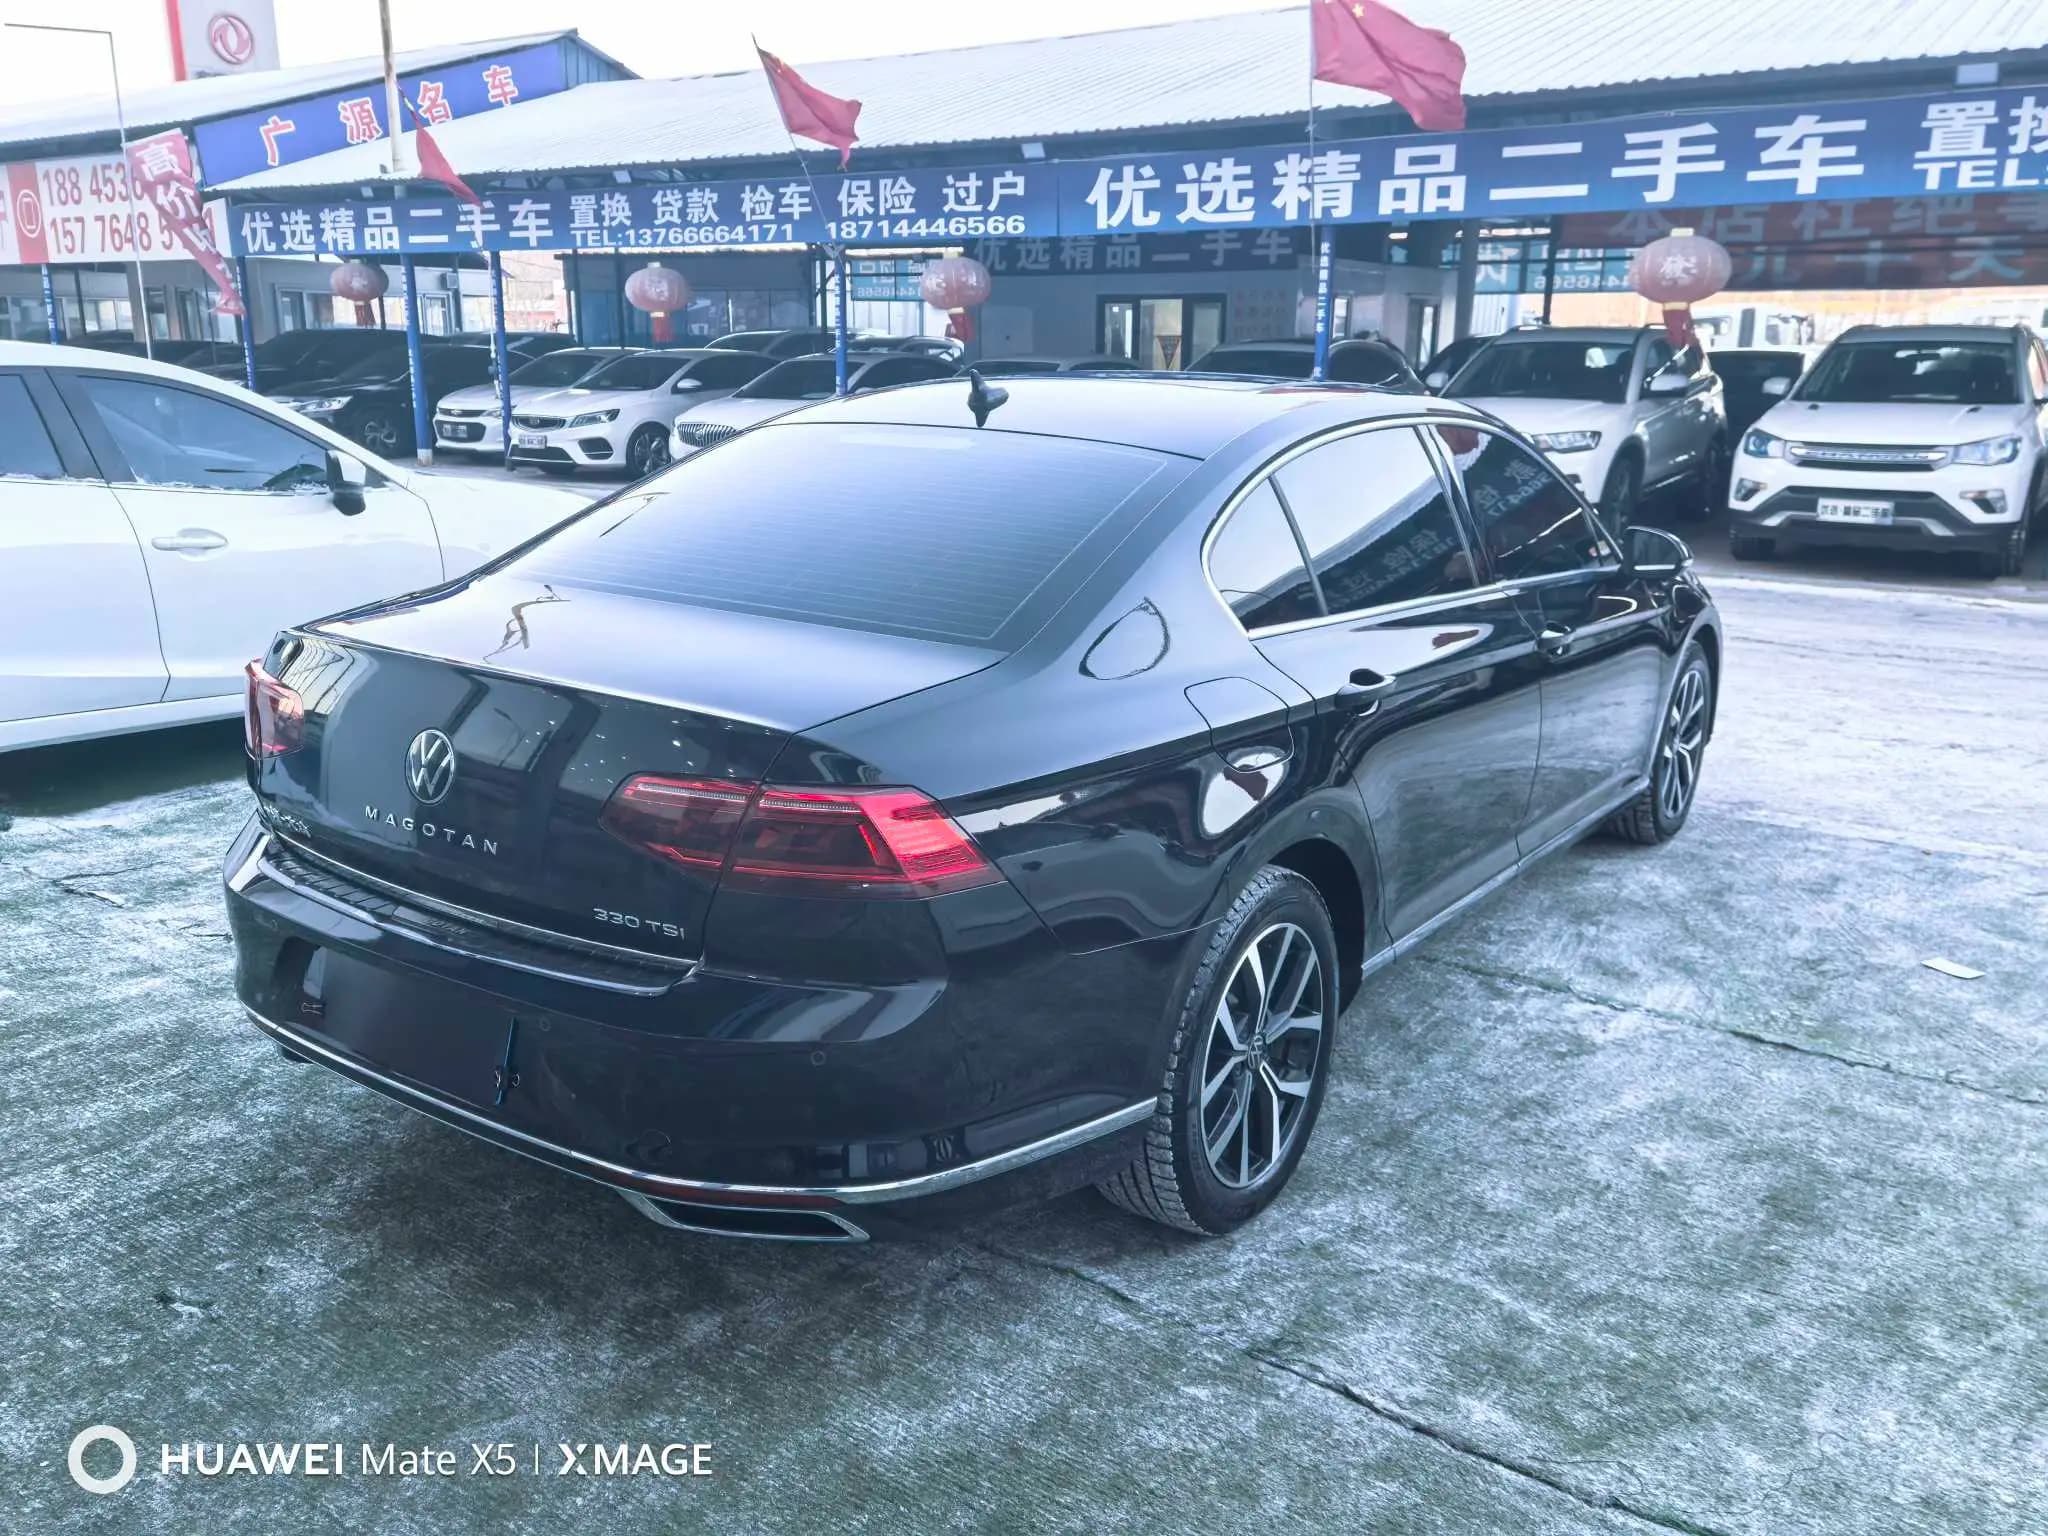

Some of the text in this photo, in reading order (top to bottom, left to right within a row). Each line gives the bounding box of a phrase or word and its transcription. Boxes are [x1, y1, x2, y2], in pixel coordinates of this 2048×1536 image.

[259, 64, 519, 167] 广源名车
[43, 167, 82, 206] 188
[1086, 114, 1867, 230] 优选精品二手车
[241, 169, 1025, 252] 优选精品二手车 置换 贷款 检车 保险 过户
[571, 216, 1025, 248] TEL:13766664171 18714446566
[50, 216, 85, 254] 157
[364, 804, 499, 856] MAGOTAN
[592, 908, 686, 941] 330 TSI
